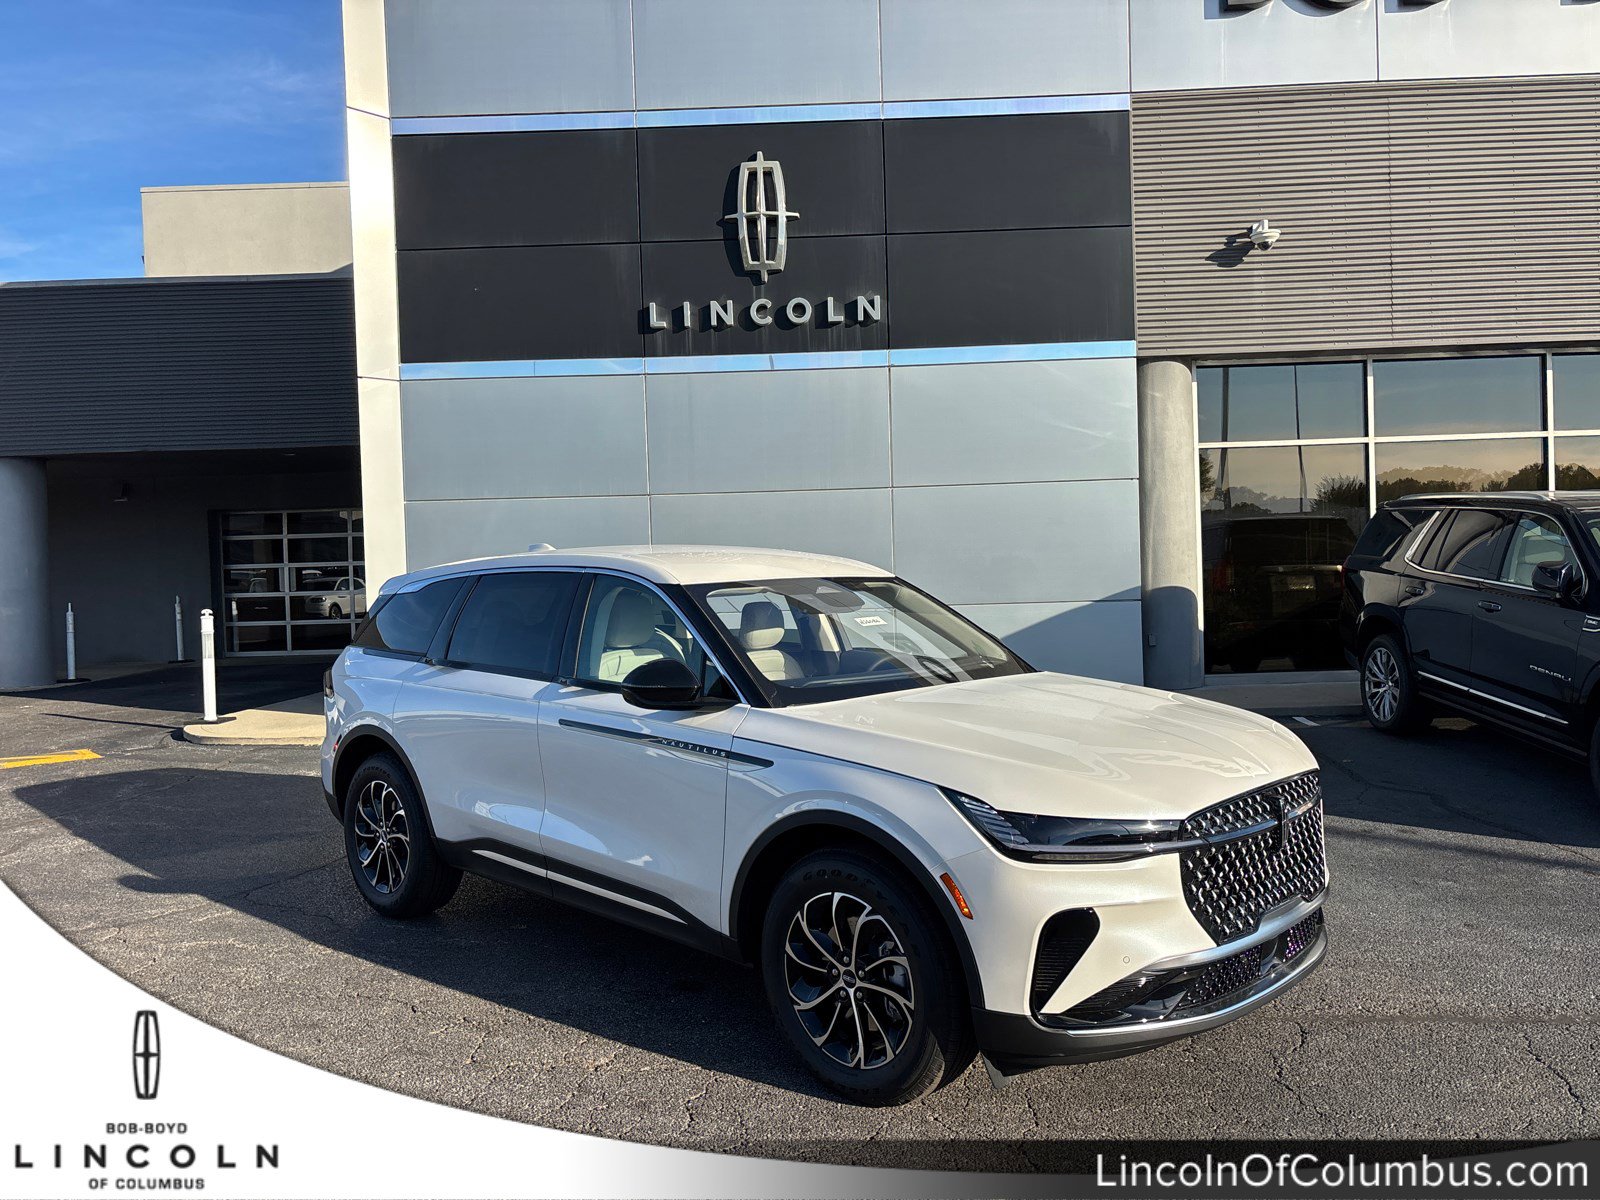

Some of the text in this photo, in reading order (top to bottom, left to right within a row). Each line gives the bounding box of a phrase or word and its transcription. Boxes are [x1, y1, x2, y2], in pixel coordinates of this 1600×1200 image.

[649, 294, 882, 329] LINCOLN
[1529, 664, 1572, 682] DENALI
[661, 739, 727, 757] NAUTILUS
